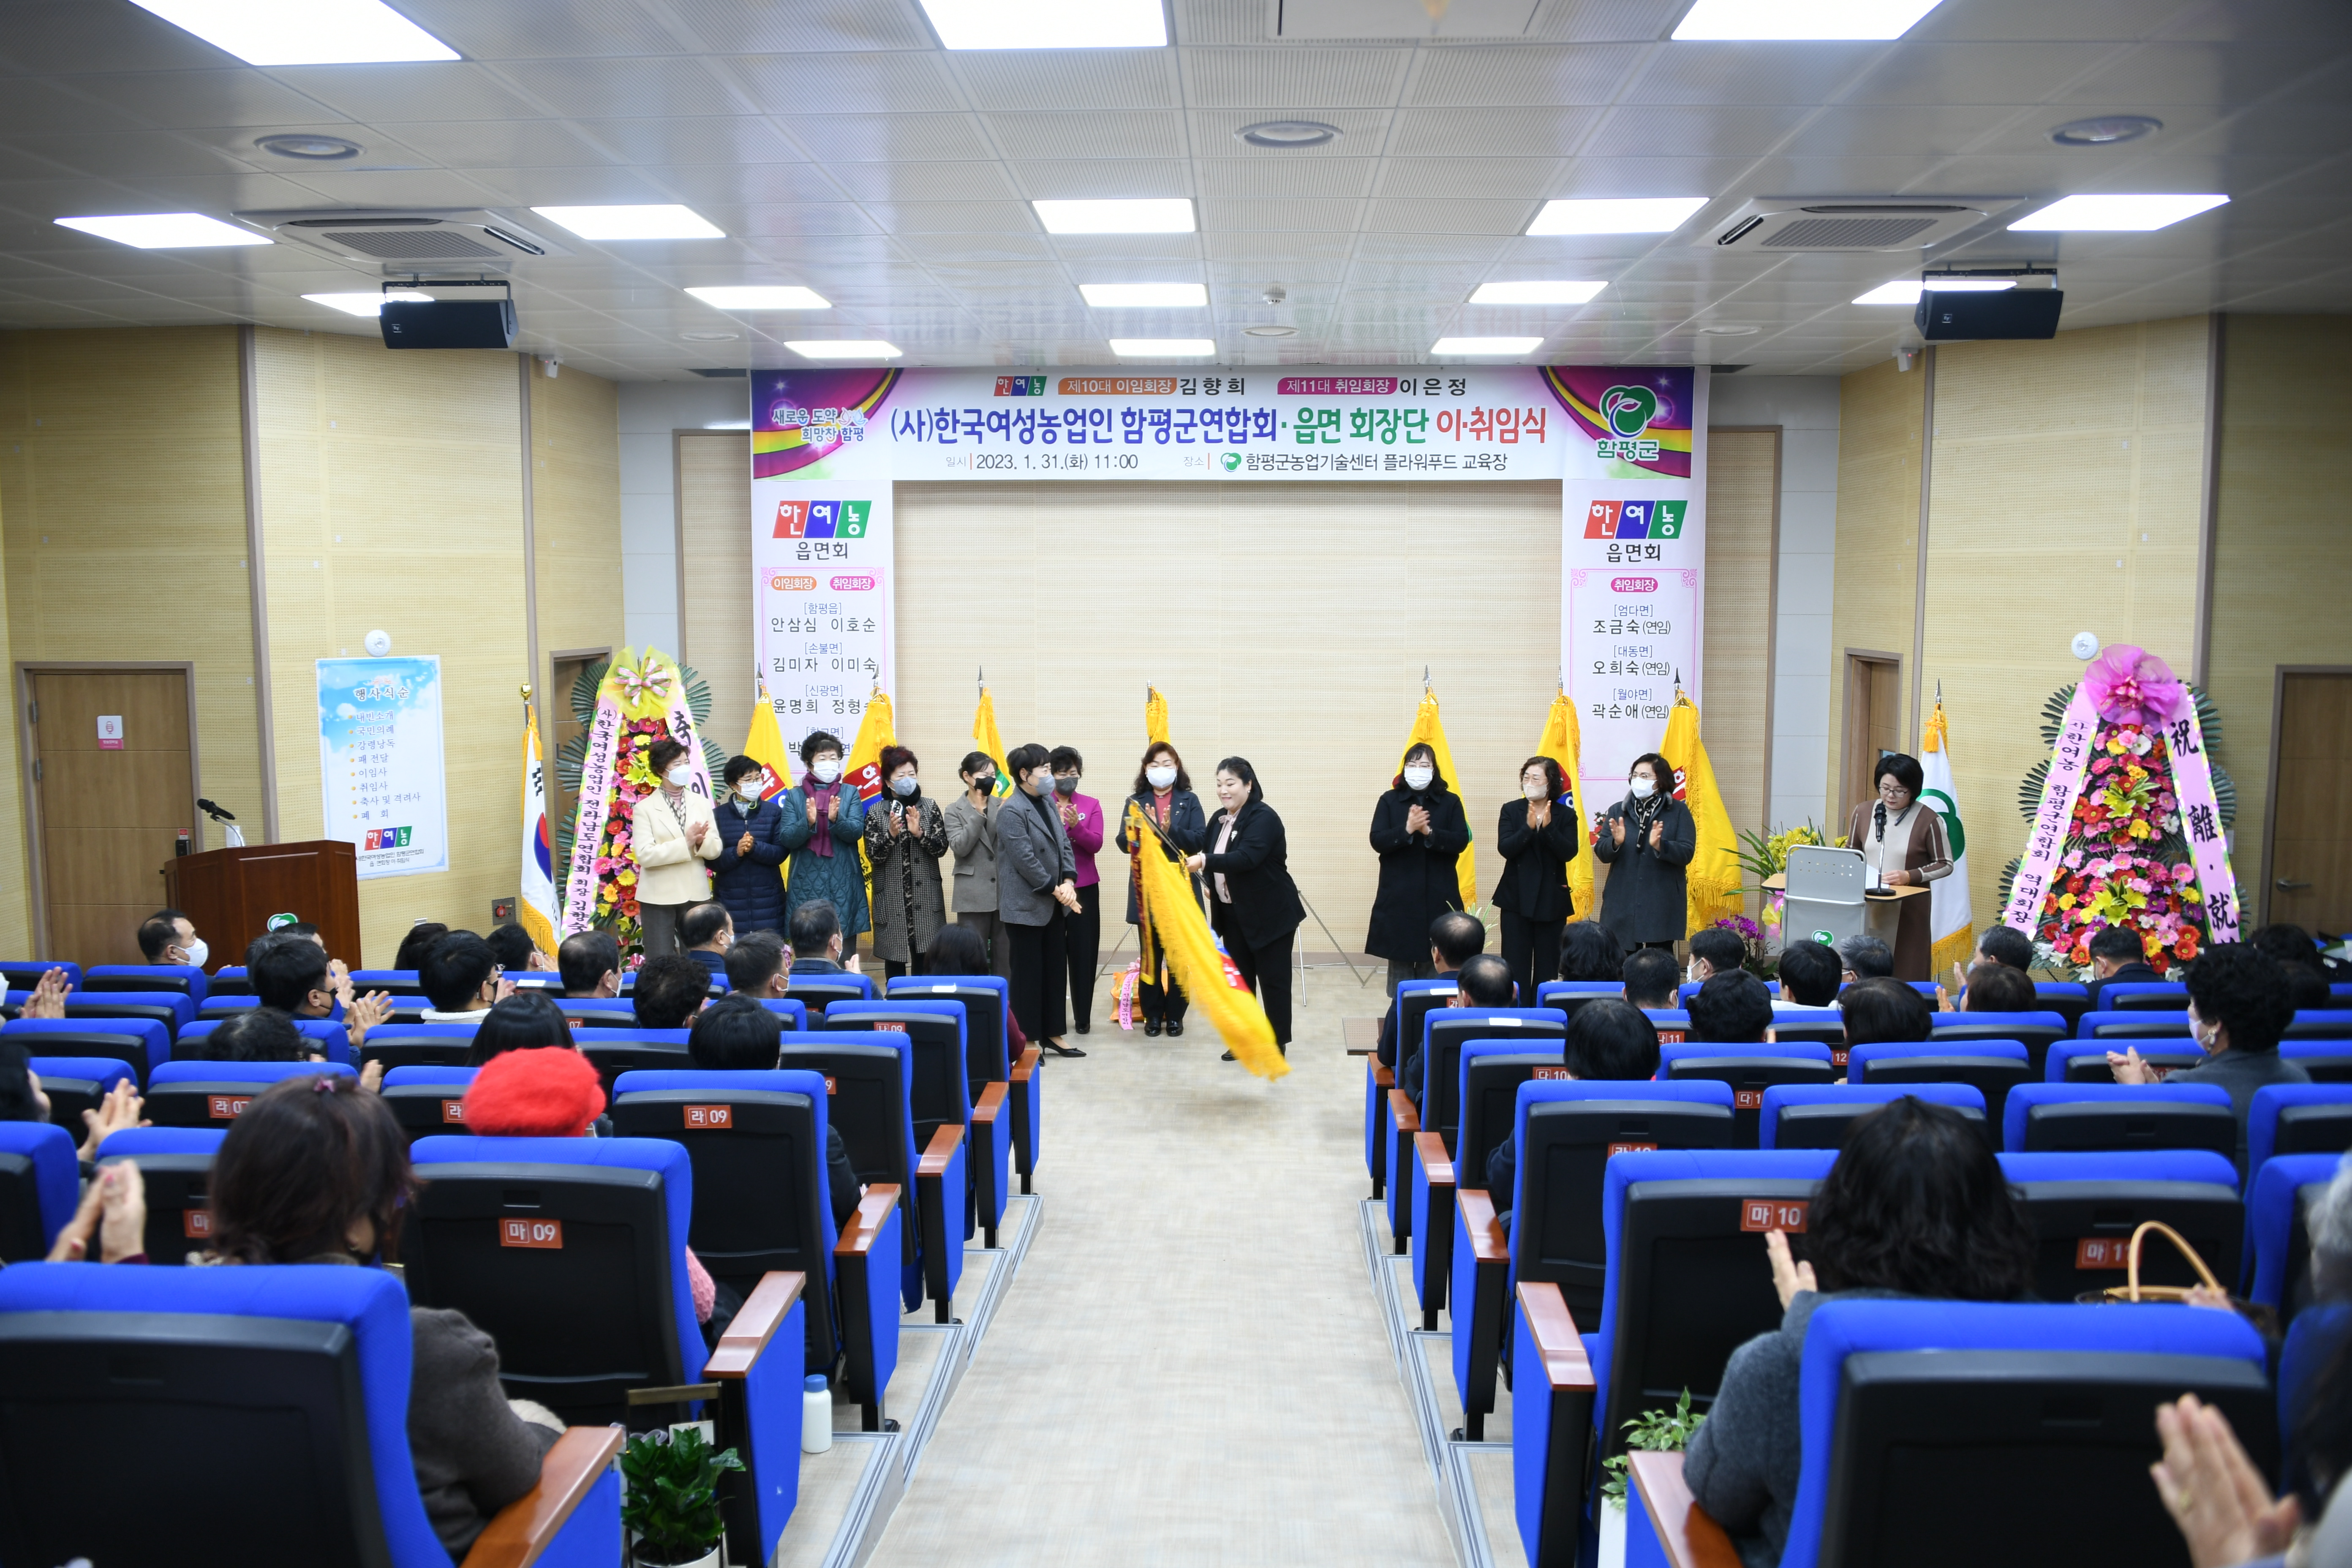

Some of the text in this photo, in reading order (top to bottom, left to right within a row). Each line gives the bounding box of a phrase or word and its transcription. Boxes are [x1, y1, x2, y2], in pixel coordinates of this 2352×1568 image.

[997, 378, 1041, 395] 한여농
[1067, 379, 1172, 394] 제10대 이임회장
[1286, 378, 1390, 394] 제11대 취임회장
[773, 408, 836, 425] 새로운 도약
[890, 407, 1113, 445] (사)한국여성농업인
[1293, 407, 1341, 444] 읍면
[1349, 407, 1429, 445] 회장단
[1437, 406, 1546, 444] 이·취임식
[803, 427, 864, 442] 희망찬 함평
[1597, 440, 1657, 460] 함평군
[946, 453, 1138, 471] 일시 2023. 1. 31.(화) 11:00
[1183, 456, 1205, 467] 장소
[1246, 453, 1508, 471] 함평군농업기술센터 플라워푸드 교육장
[779, 504, 861, 536] 한여농
[1591, 504, 1675, 536] 한여농
[795, 541, 848, 561] 읍면회
[1606, 543, 1661, 563] 읍면회
[774, 577, 814, 590] 이임회장
[832, 577, 872, 590] 취임회장
[1614, 579, 1655, 592] 취임회장
[804, 602, 842, 615] [함평읍]
[1614, 604, 1653, 618] [엄다면]
[771, 617, 876, 633] 안삼심 이호순
[805, 642, 843, 655] [손불면]
[1613, 645, 1653, 659] [대동면]
[773, 657, 877, 673] 김미자 이미숙
[354, 686, 409, 701] 행사식순
[805, 684, 843, 697] [신광면]
[1613, 688, 1652, 702] [월야면]
[773, 699, 818, 714] 윤명희
[356, 710, 394, 722] 내빈소개
[356, 724, 394, 736] 국민의례
[674, 711, 691, 746] 축
[357, 738, 395, 751] 강령낭독
[586, 707, 617, 795] (사)한국여성농업인
[2056, 719, 2088, 771] (사)한여농
[358, 753, 389, 764] 패 전달
[358, 767, 388, 779] 이임사
[359, 781, 388, 792] 취임사
[360, 792, 422, 806] 축사 및 격려사
[2031, 784, 2071, 863] 함평군연합회
[367, 829, 408, 849] 한여농
[573, 798, 602, 875] 전라남도연합회
[573, 878, 591, 896] 회장
[2010, 874, 2043, 924] 역대회장
[1669, 1034, 1680, 1043] 11
[1835, 1053, 1847, 1062] 12
[1553, 1070, 1568, 1080] 10
[215, 1100, 228, 1113] 라
[1740, 1093, 1751, 1105] 다
[449, 1105, 462, 1119] 라
[691, 1110, 727, 1124] 라 09
[193, 1214, 210, 1231] 마
[1751, 1206, 1802, 1226] 마 10
[509, 1222, 556, 1241] 마 09
[2087, 1244, 2104, 1261] 마
